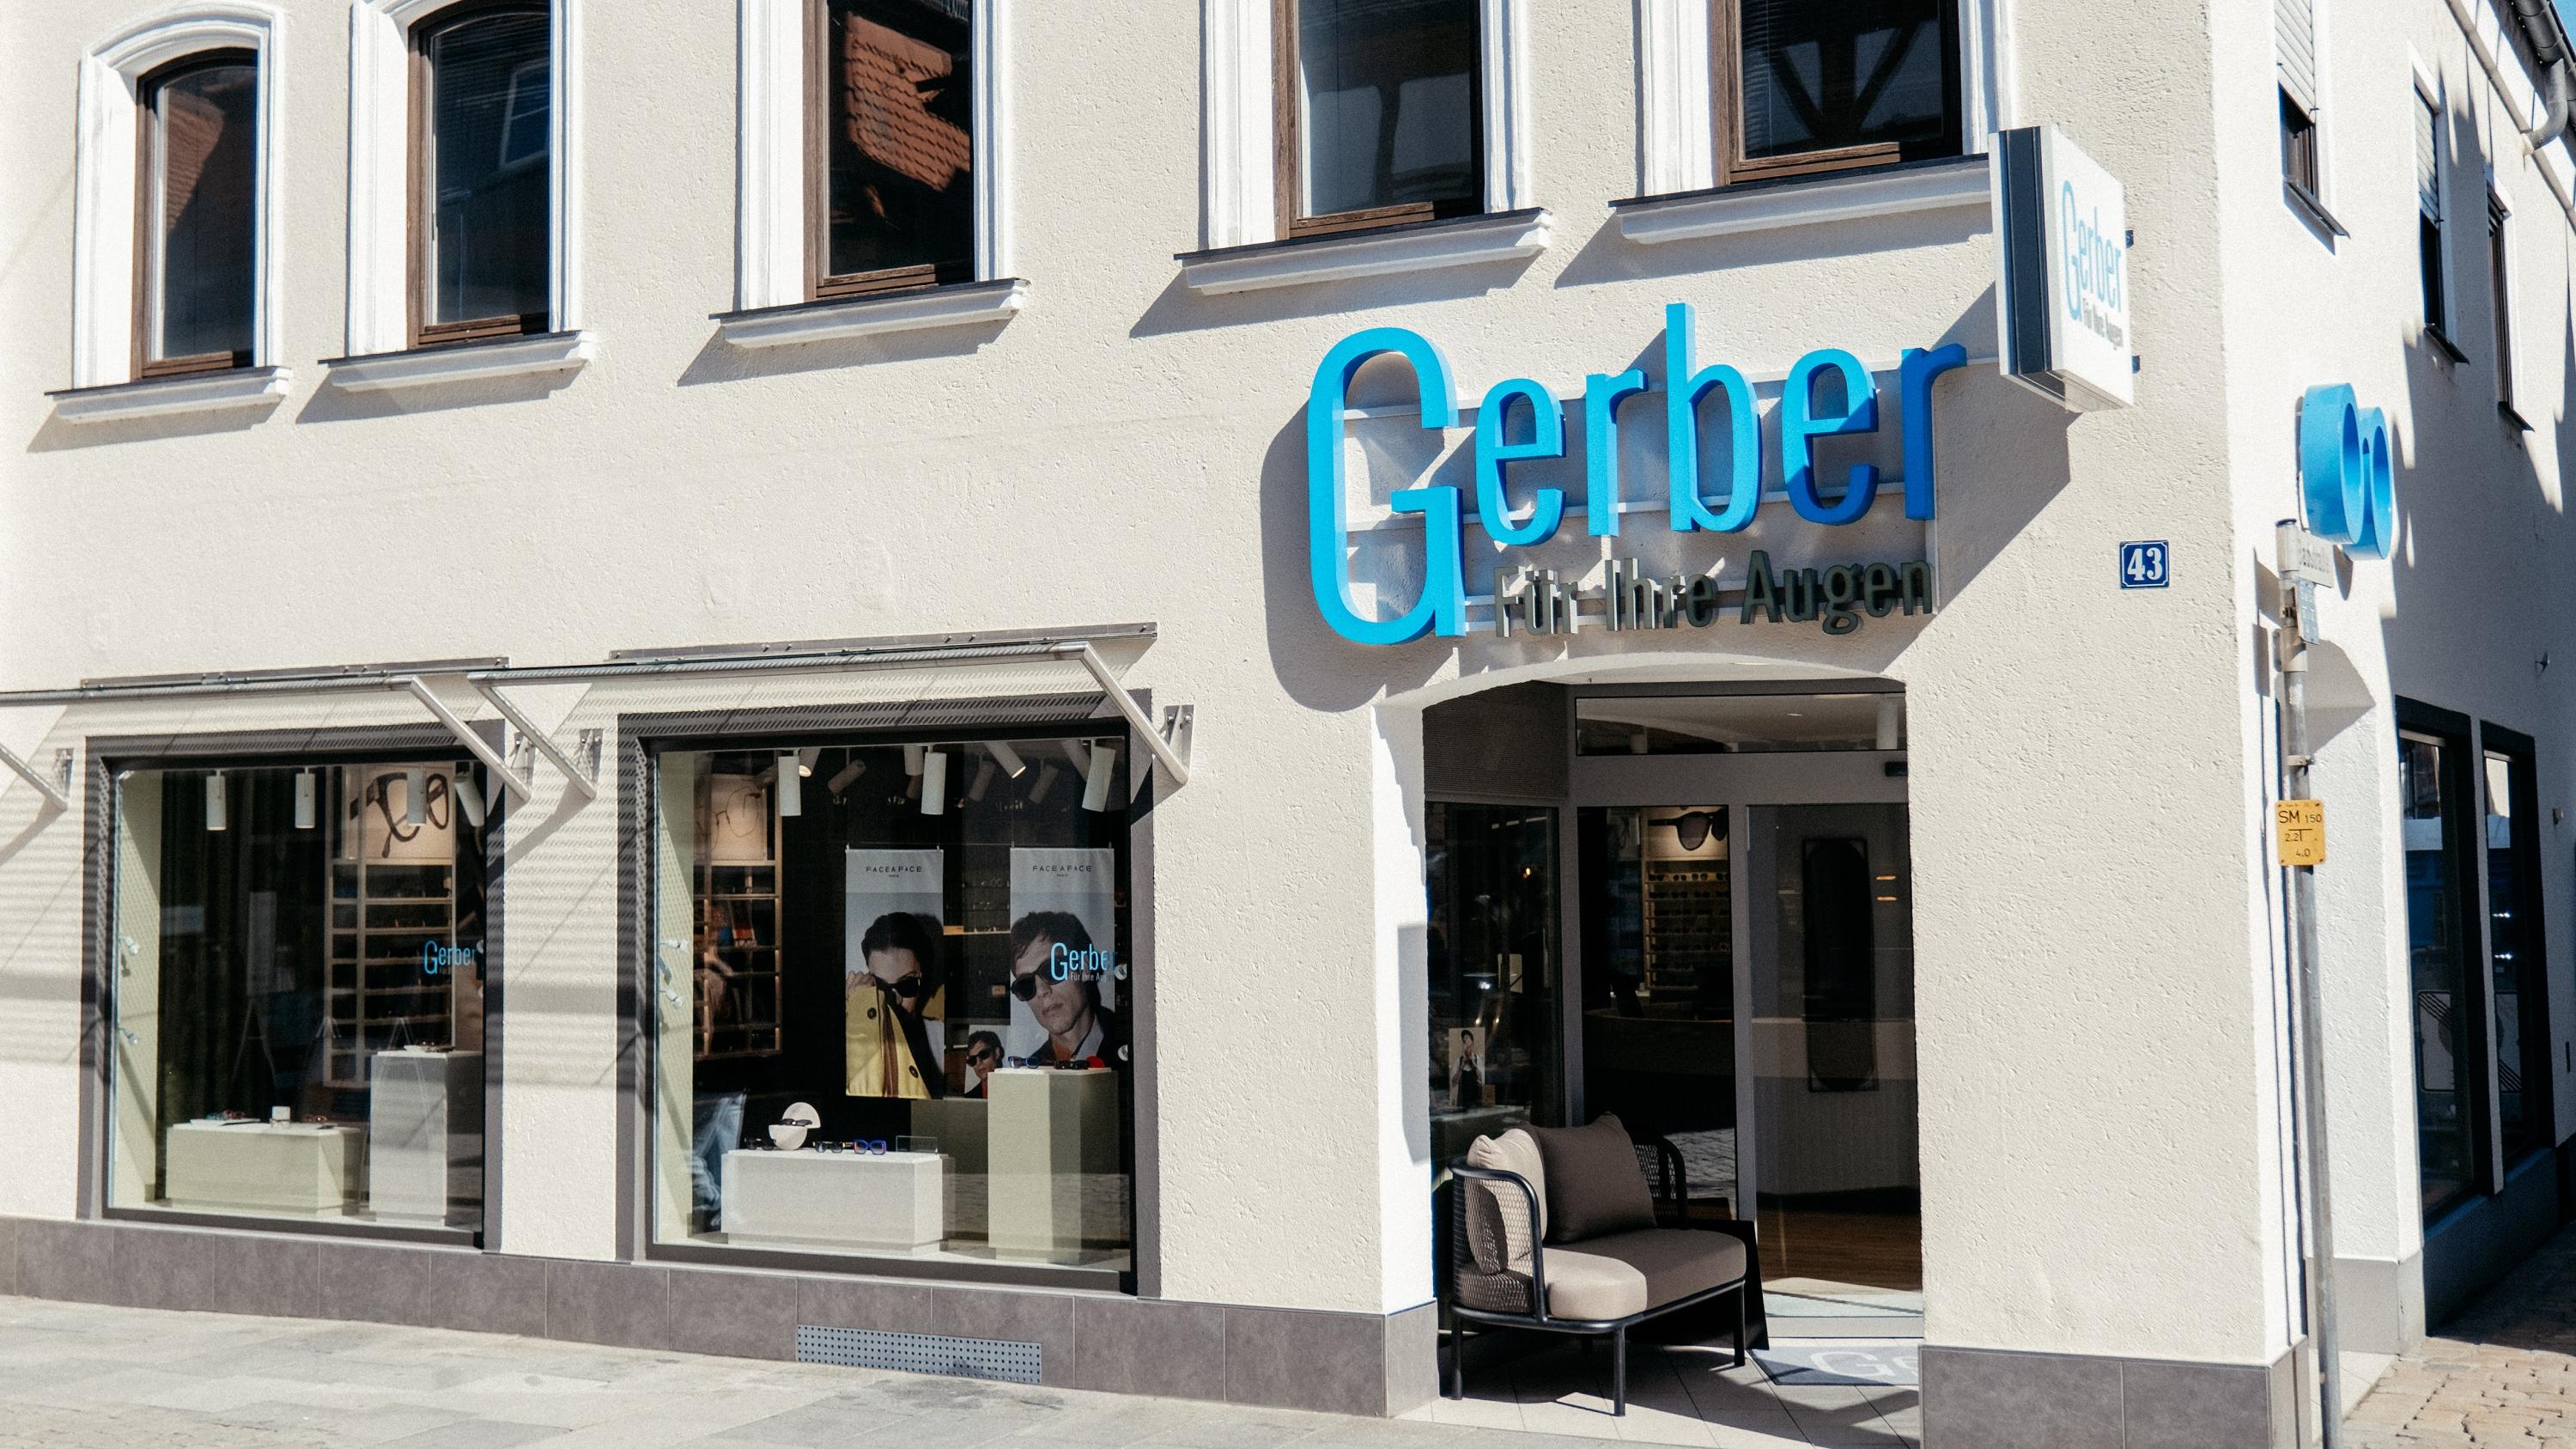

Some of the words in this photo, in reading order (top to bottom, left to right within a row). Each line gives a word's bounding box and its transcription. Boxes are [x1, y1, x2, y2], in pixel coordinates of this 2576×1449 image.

[2063, 180, 2122, 322] Gerber
[1308, 302, 1967, 645] Gerber
[1495, 565, 1578, 637] Für
[1605, 557, 1716, 633] Ihre
[1740, 550, 1933, 635] Augen
[2127, 547, 2163, 581] 43
[2278, 810, 2300, 824] SM
[2305, 813, 2323, 824] 150
[424, 940, 477, 975] Gerber
